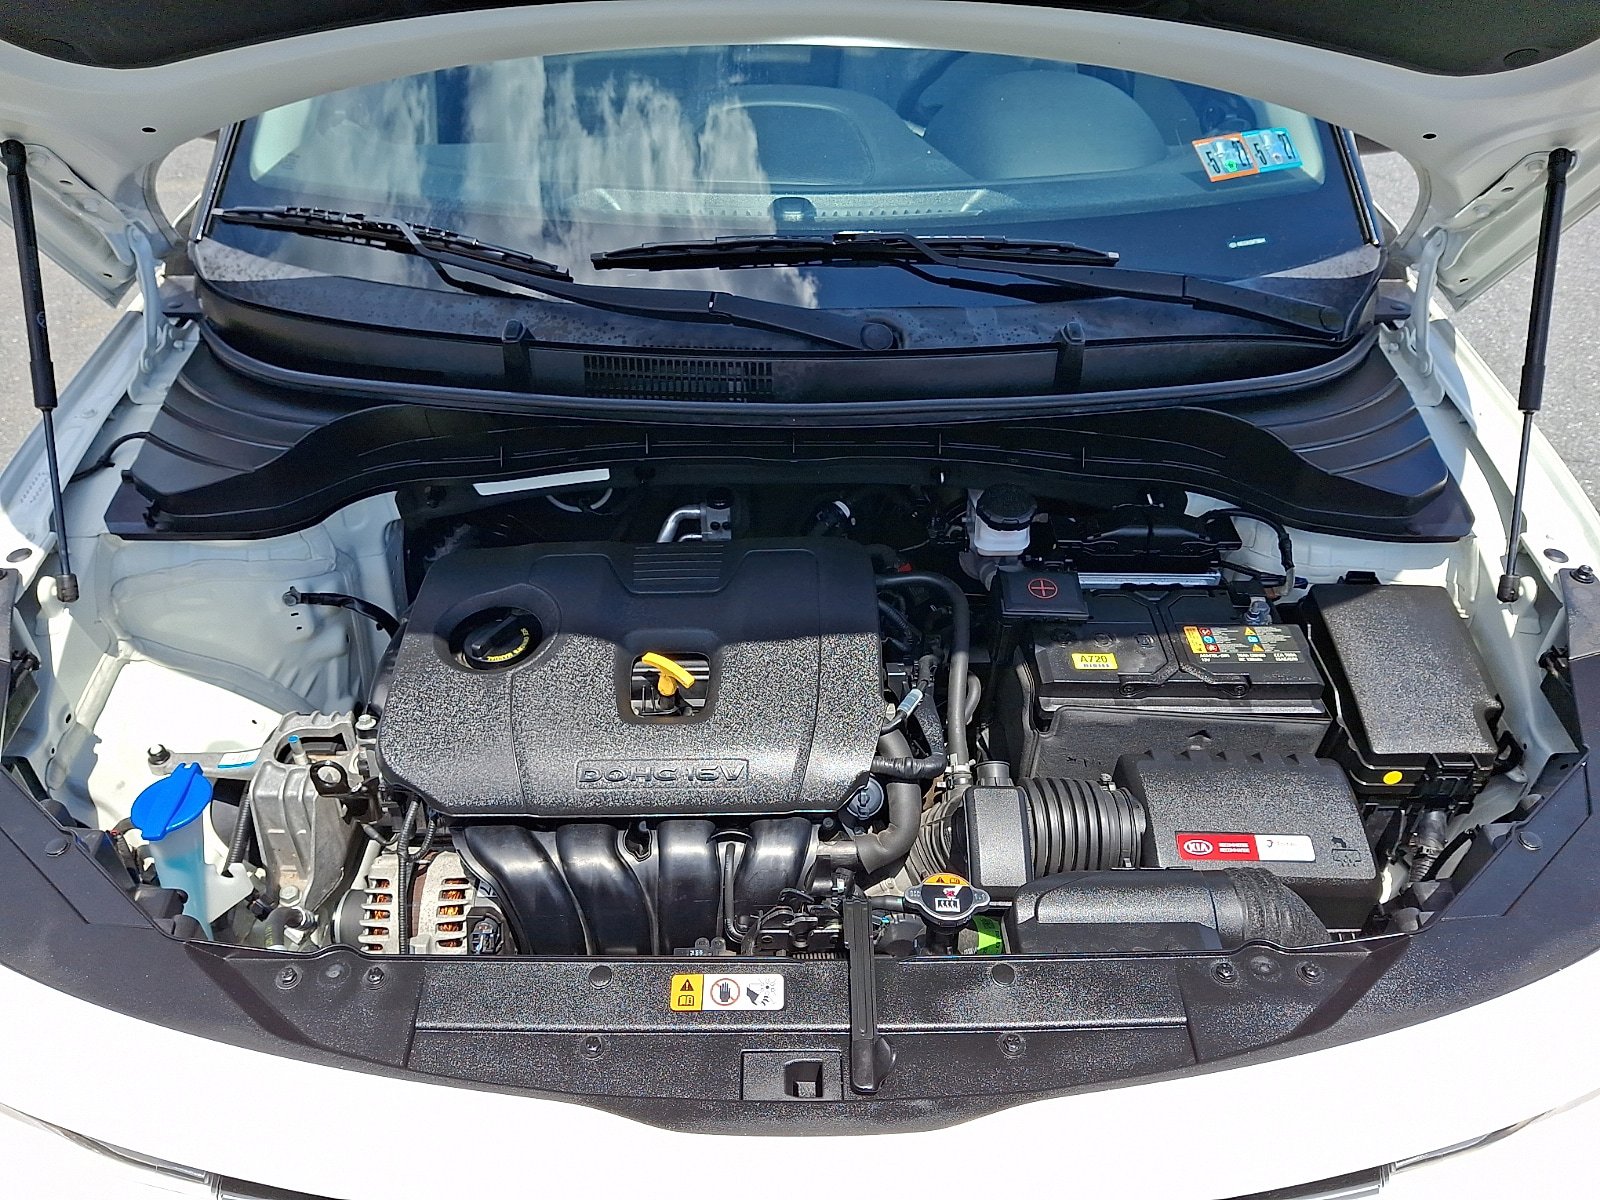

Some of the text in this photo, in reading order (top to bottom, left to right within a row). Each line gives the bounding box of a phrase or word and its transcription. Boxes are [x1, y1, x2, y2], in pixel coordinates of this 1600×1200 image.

[1205, 151, 1221, 174] 5
[1253, 143, 1268, 166] 5
[1080, 655, 1108, 664] A720
[579, 765, 745, 783] DOHC 16V
